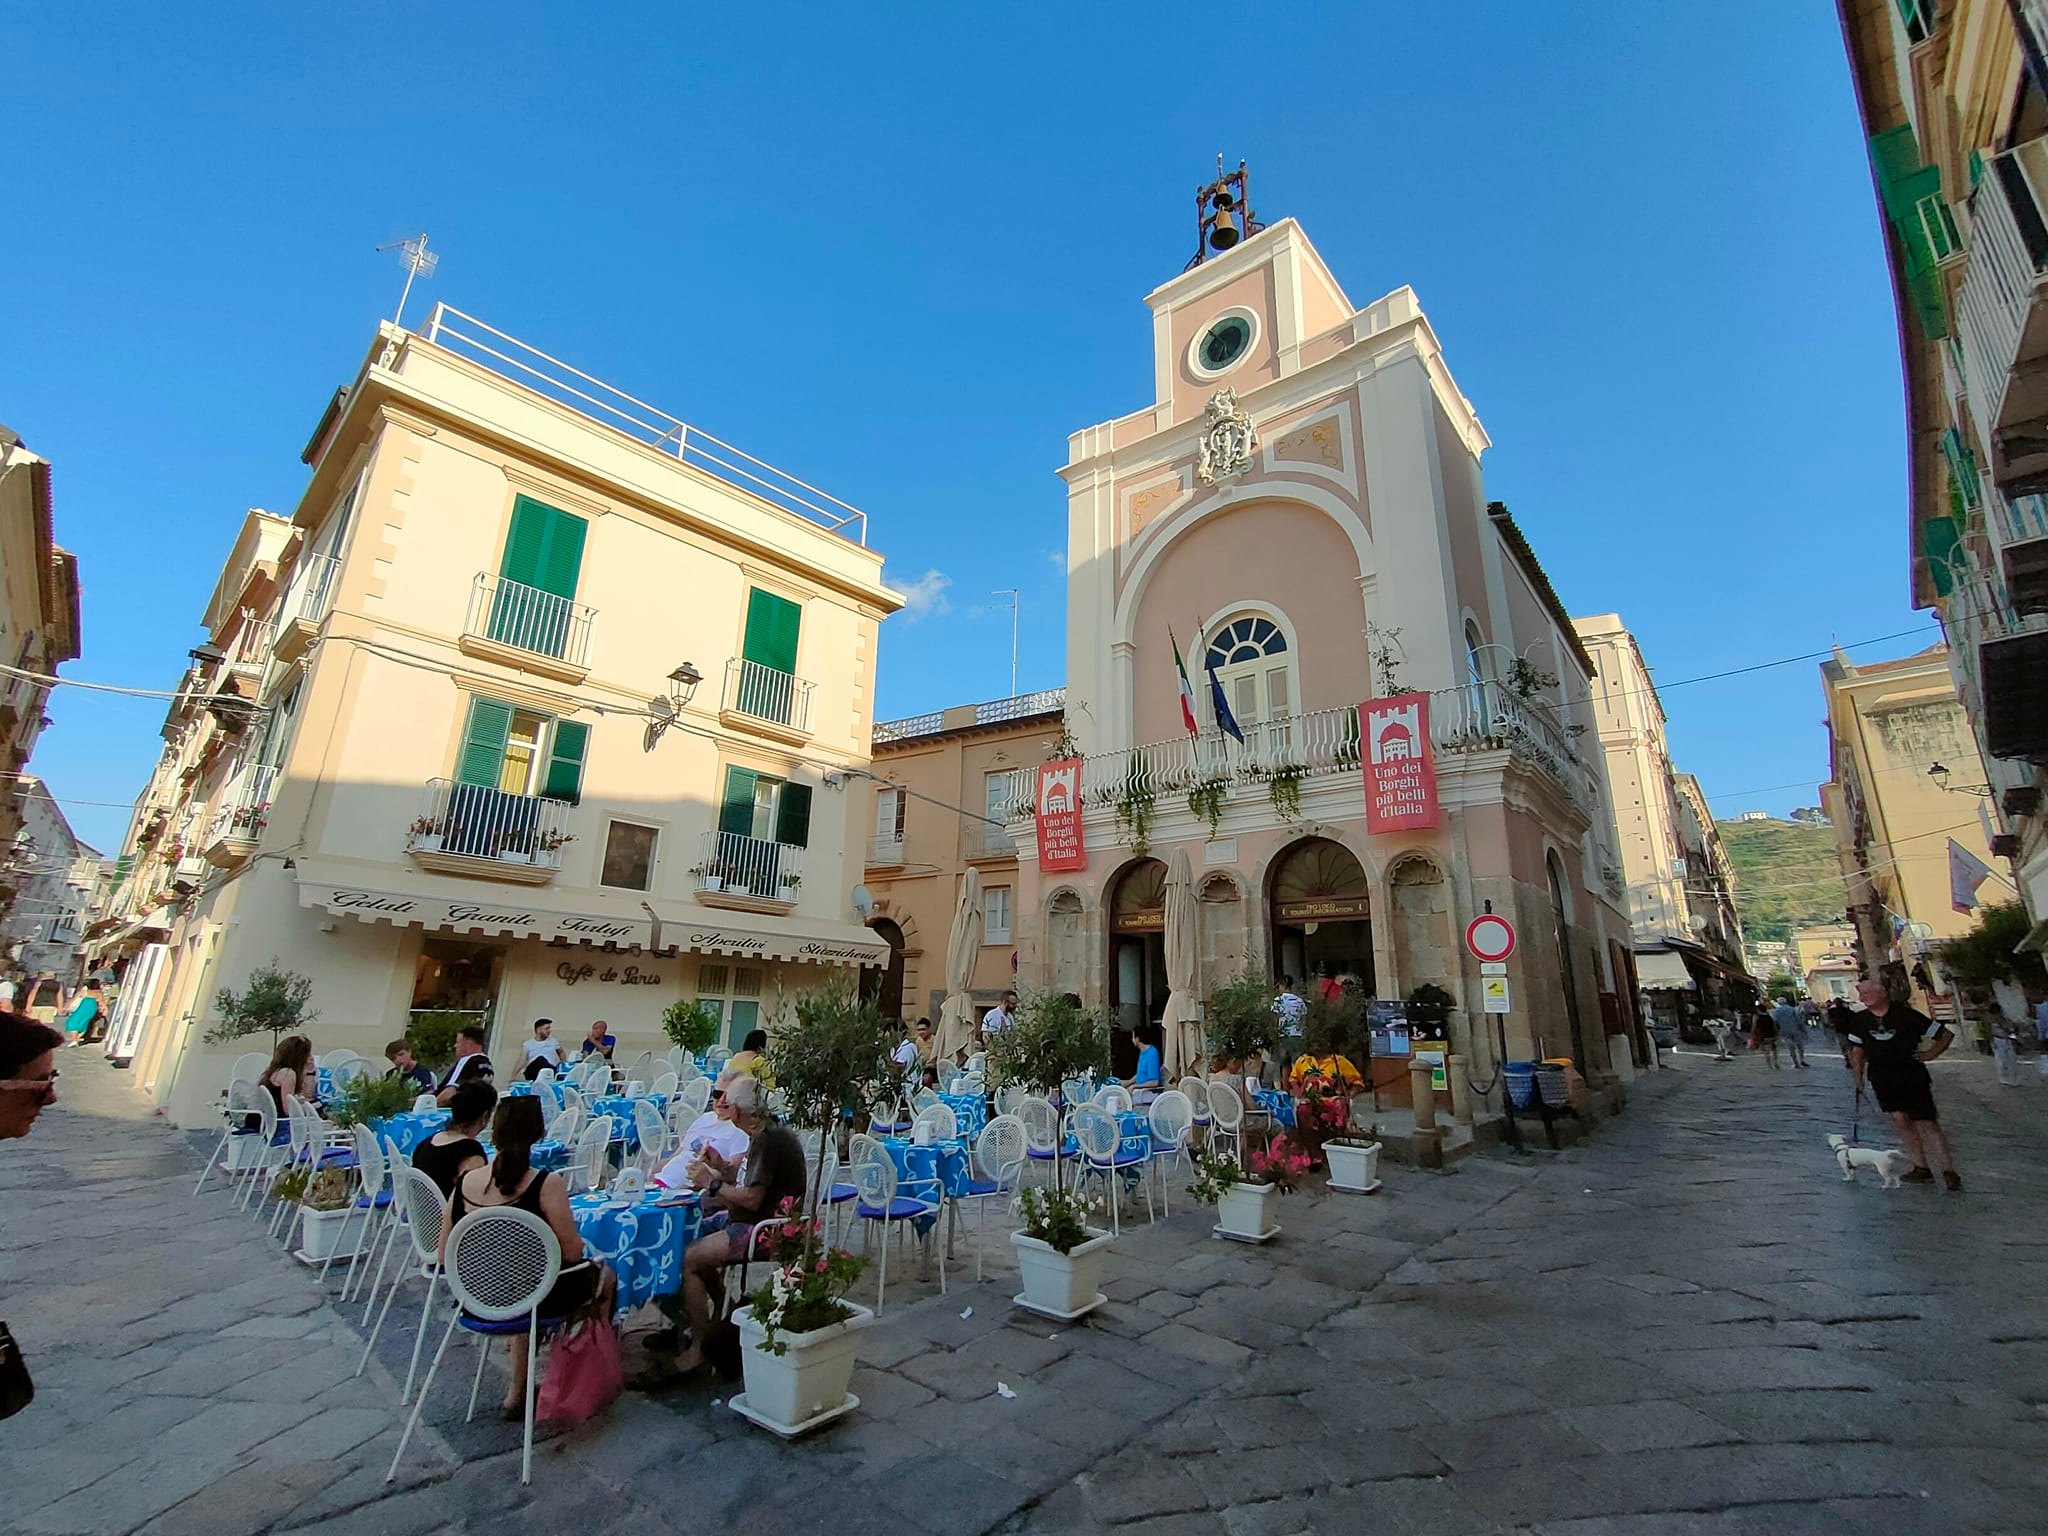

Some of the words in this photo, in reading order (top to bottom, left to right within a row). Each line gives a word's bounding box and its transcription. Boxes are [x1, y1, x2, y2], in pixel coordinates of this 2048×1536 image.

[1375, 766, 1398, 779] Uno
[1401, 761, 1421, 774] dei
[1378, 775, 1420, 792] Borghi
[1375, 791, 1394, 809] più
[1396, 788, 1426, 801] belli
[1380, 802, 1423, 818] d'Italia
[1043, 817, 1060, 828] Uno
[1046, 825, 1074, 839] Borghi
[1059, 836, 1078, 848] belli
[328, 890, 419, 913] Gelati
[441, 904, 537, 926] Granite
[556, 917, 635, 938] Tartufi
[690, 932, 769, 948] Aperitivi
[556, 962, 597, 986] Café
[600, 967, 618, 982] de
[620, 966, 662, 985] Paris
